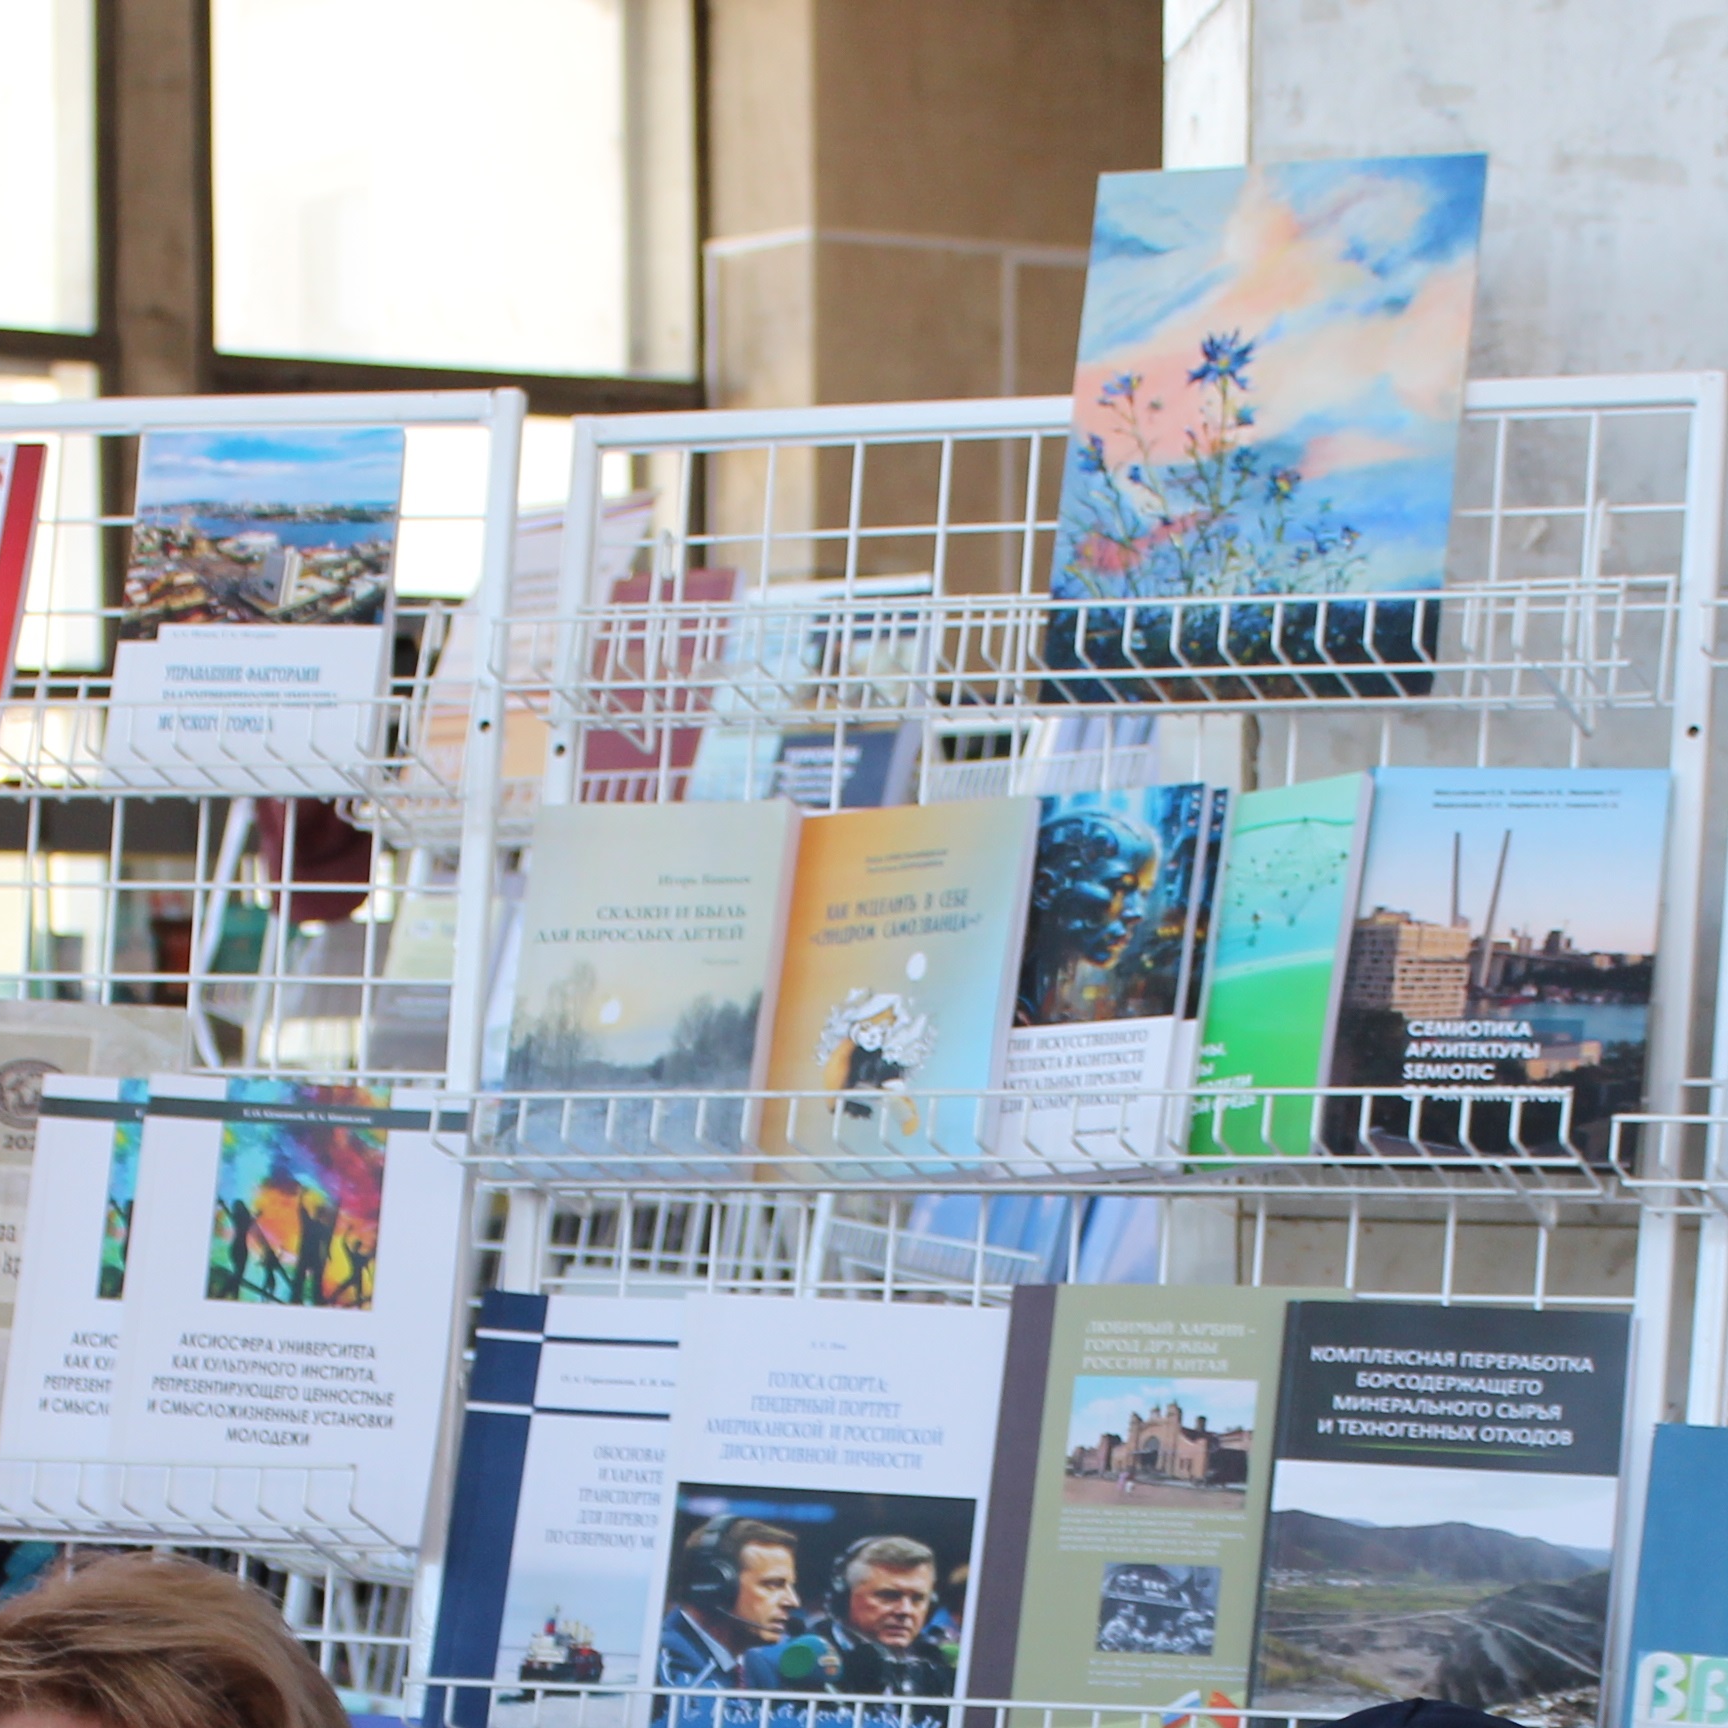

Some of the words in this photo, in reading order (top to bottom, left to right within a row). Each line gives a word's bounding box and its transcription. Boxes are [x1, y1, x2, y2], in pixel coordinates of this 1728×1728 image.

[1407, 1020, 1532, 1037] СЕМИОТИКА
[1404, 1042, 1542, 1059] АРХИТЕКТУРЫ
[1402, 1062, 1496, 1081] SEMIOTIC
[180, 1332, 273, 1351] АКСИОСФЕРА
[278, 1339, 375, 1360] УНИВЕРСИТЕТА
[172, 1355, 199, 1371] КАК
[203, 1356, 297, 1378] КУЛЬТУРНОГО
[1310, 1346, 1456, 1367] КОМПЛЕКСНАЯ
[1459, 1352, 1595, 1373] ПЕРЕРАБОТКА
[1356, 1371, 1543, 1397] БОРСОДЕРЖАЩЕГО
[147, 1397, 157, 1412] И
[312, 1409, 393, 1430] УСТАНОВКИ
[1332, 1395, 1492, 1418] МИНЕРАЛЬНОГО
[1495, 1402, 1562, 1421] СЫРЬЯ
[1318, 1419, 1332, 1434] И
[1337, 1419, 1476, 1442] ТЕХНОГЕННЫХ
[1479, 1426, 1573, 1448] ОТХОДОВ
